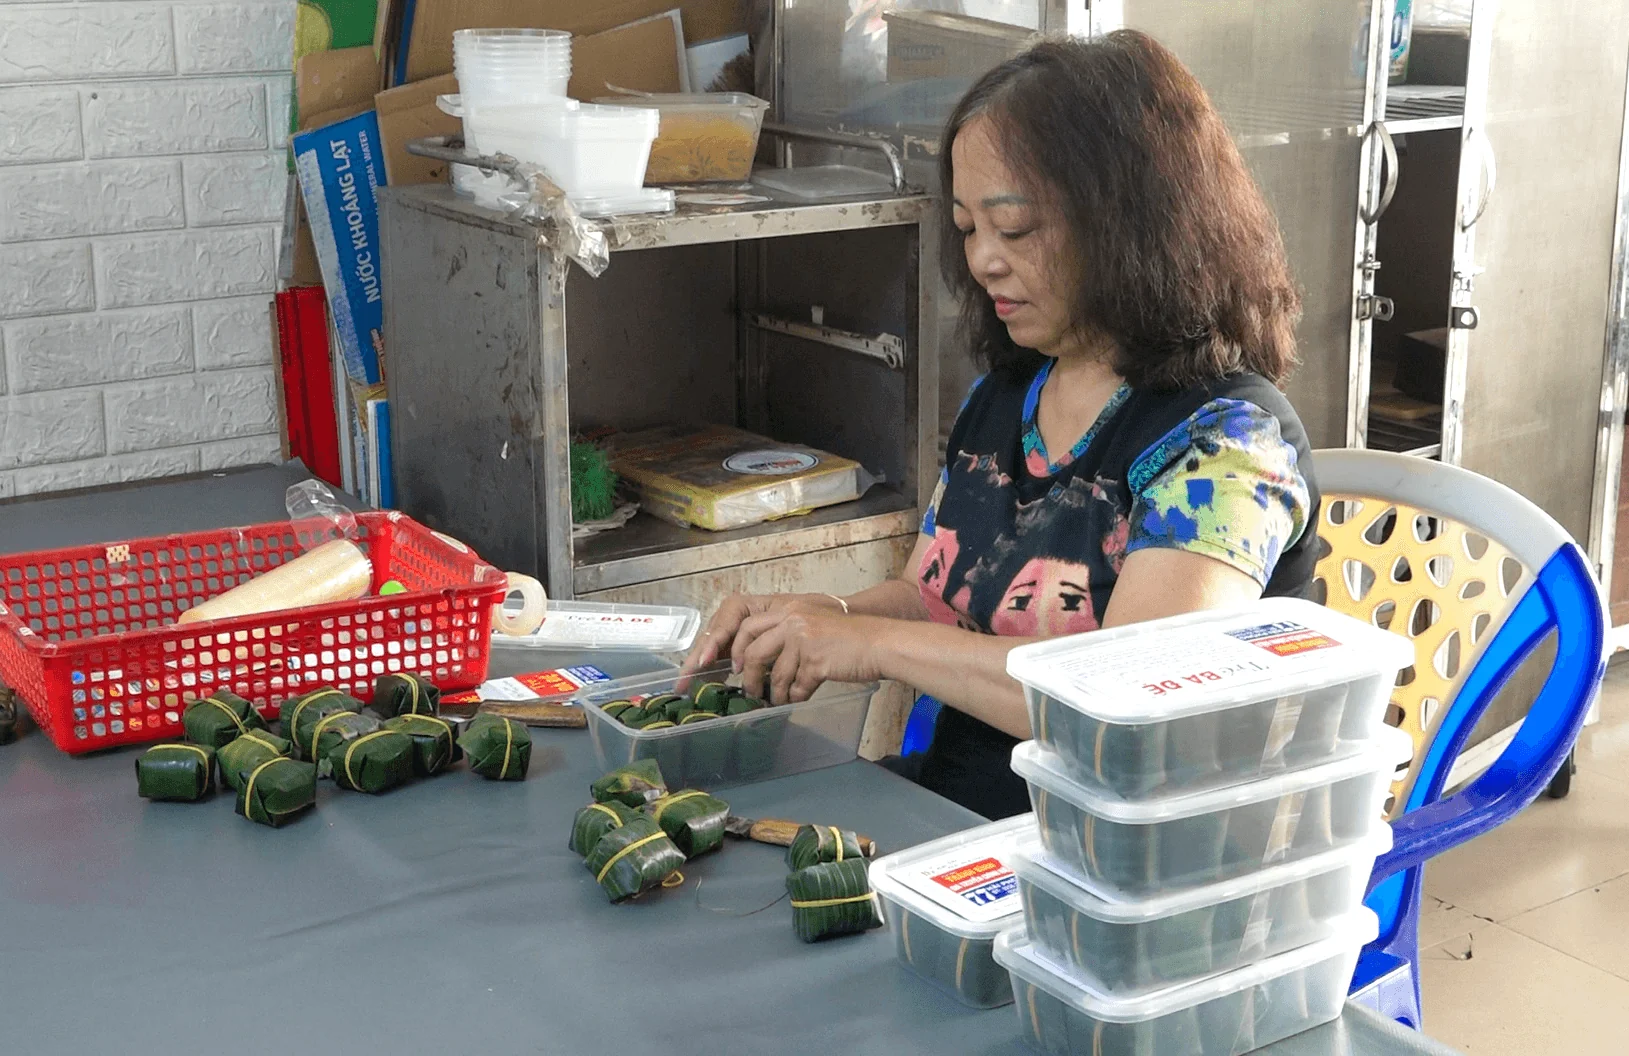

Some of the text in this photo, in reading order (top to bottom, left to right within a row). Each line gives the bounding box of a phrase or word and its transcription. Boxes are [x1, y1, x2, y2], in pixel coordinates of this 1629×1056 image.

[330, 140, 352, 172] LẠT
[359, 130, 371, 162] WATER
[339, 172, 368, 250] KHOÁNG
[355, 251, 380, 303] NƯỚC
[964, 888, 996, 904] 77
